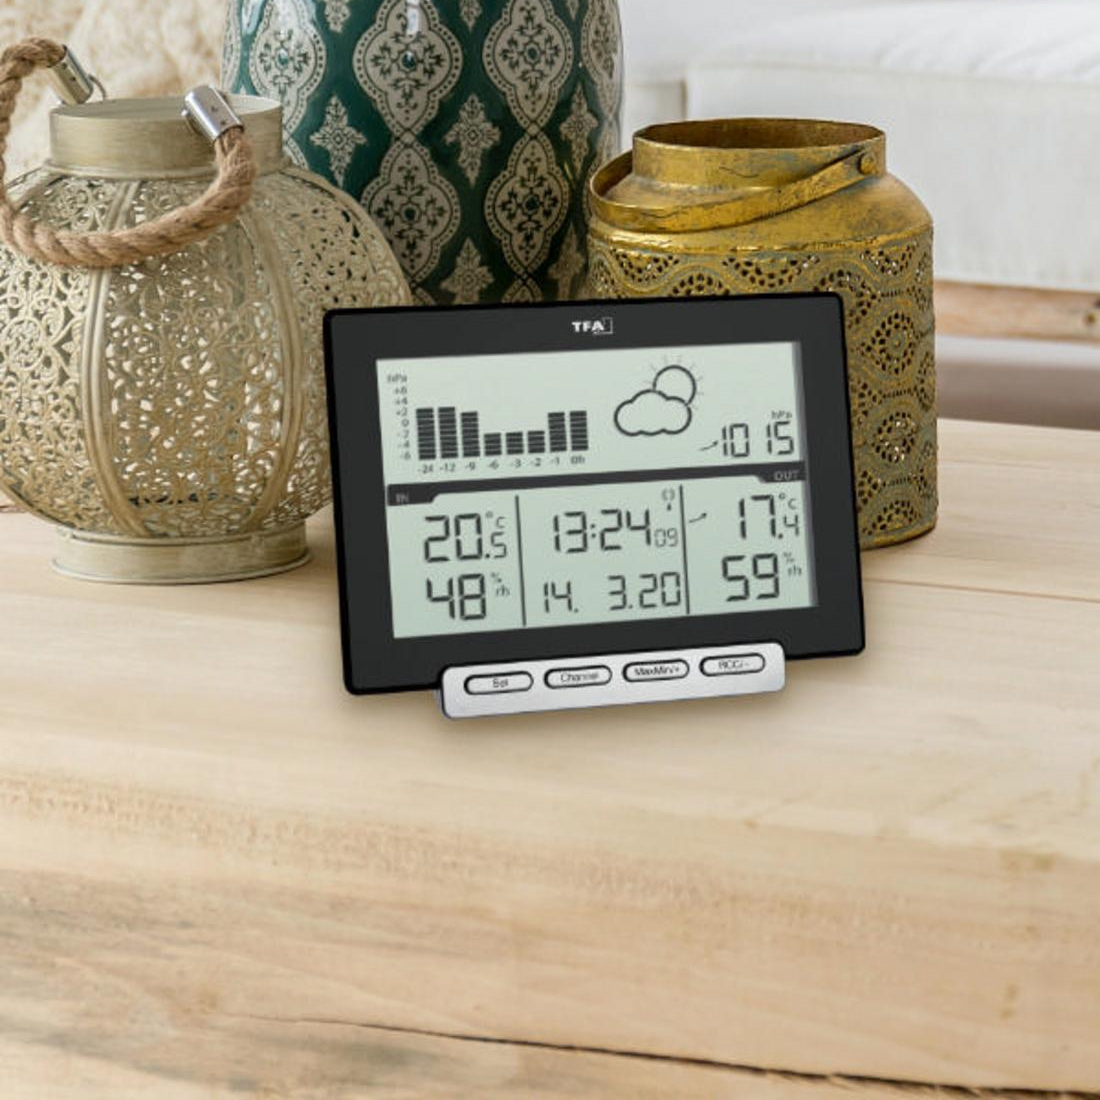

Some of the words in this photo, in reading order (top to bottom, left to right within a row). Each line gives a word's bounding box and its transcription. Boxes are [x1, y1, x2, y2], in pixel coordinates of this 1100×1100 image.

[571, 320, 604, 333] TFA
[774, 469, 800, 481] OUT
[553, 509, 651, 554] 13:24
[654, 528, 679, 548] 09
[426, 573, 487, 620] 48
[722, 553, 780, 602] 59
